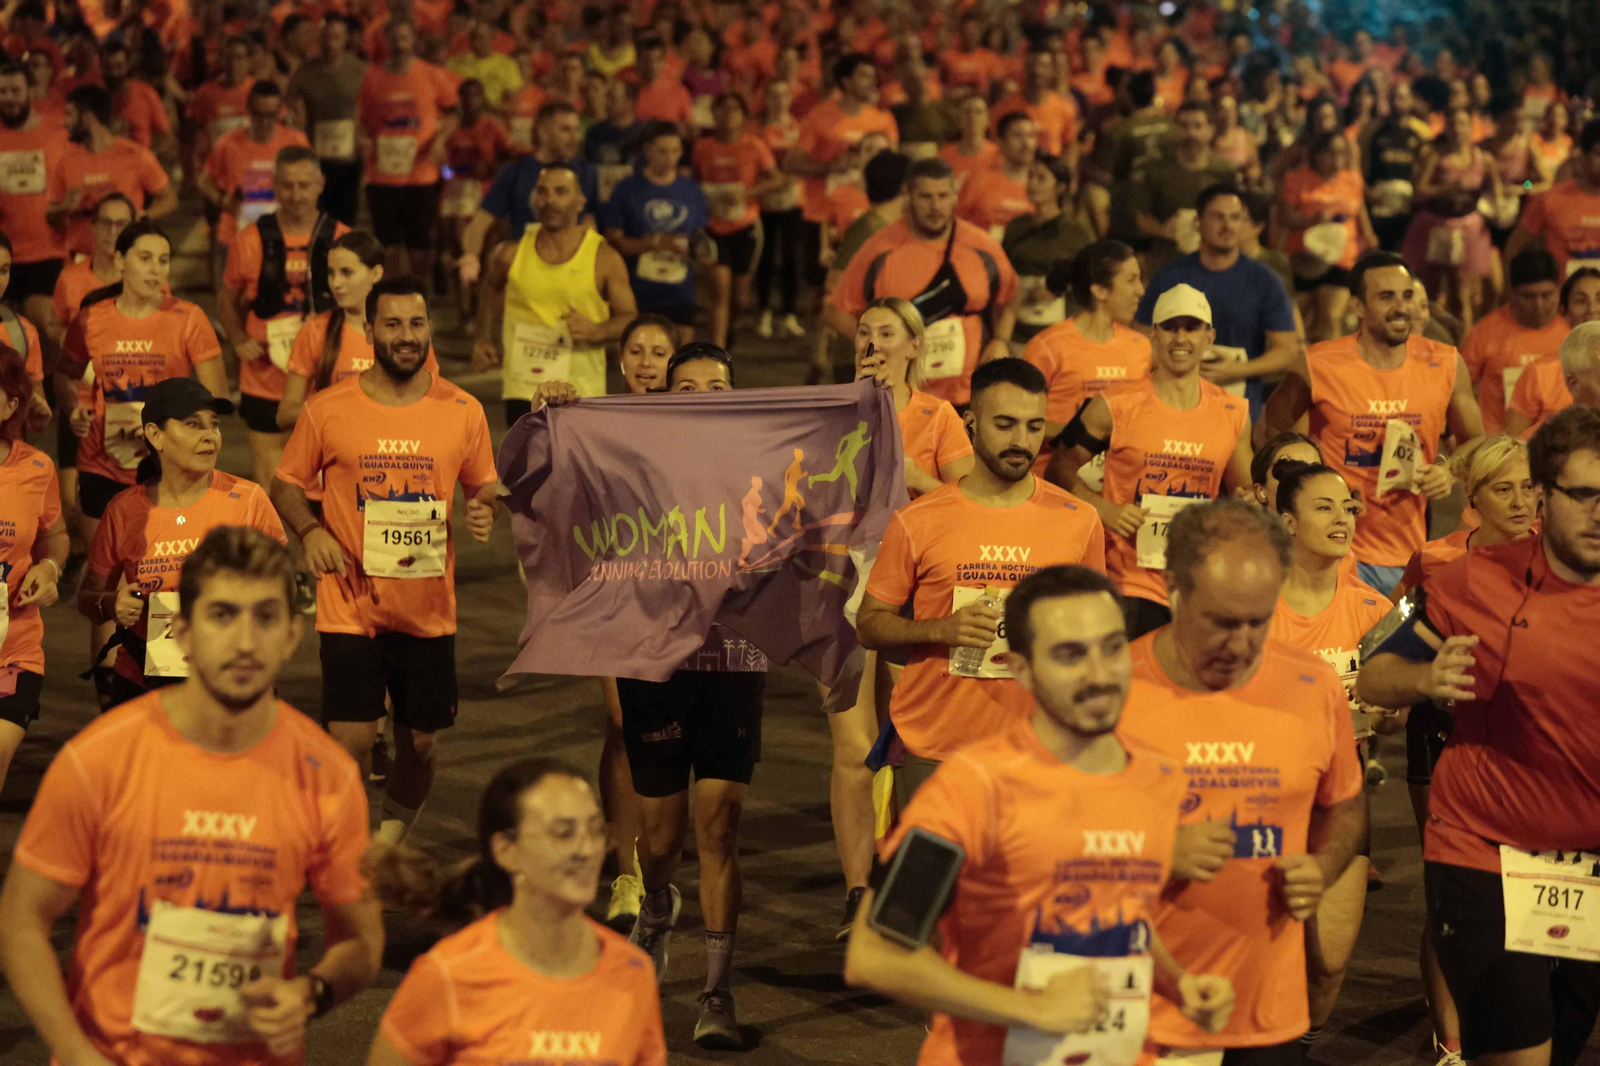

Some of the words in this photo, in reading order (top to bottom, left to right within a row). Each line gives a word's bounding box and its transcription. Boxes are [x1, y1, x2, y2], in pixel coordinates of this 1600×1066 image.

[116, 340, 153, 352] XXXV
[1368, 399, 1408, 413] XXXV
[377, 439, 420, 453] XXXV
[1163, 439, 1203, 455] XXXV
[364, 461, 433, 471] GUADALQUIVIR
[1149, 459, 1214, 472] GUADALQUIVIR
[381, 528, 431, 546] 19561
[573, 502, 726, 560] WOMAN
[154, 538, 199, 556] XXXV
[979, 545, 1031, 562] XXXV
[135, 557, 170, 566] CARRERA
[648, 558, 732, 580] EVOLUTION
[1186, 742, 1255, 764] XXXV
[182, 809, 257, 838] XXXV
[1082, 830, 1146, 856] XXXV
[1533, 884, 1584, 910] 7817
[529, 1030, 602, 1059] XXXV
